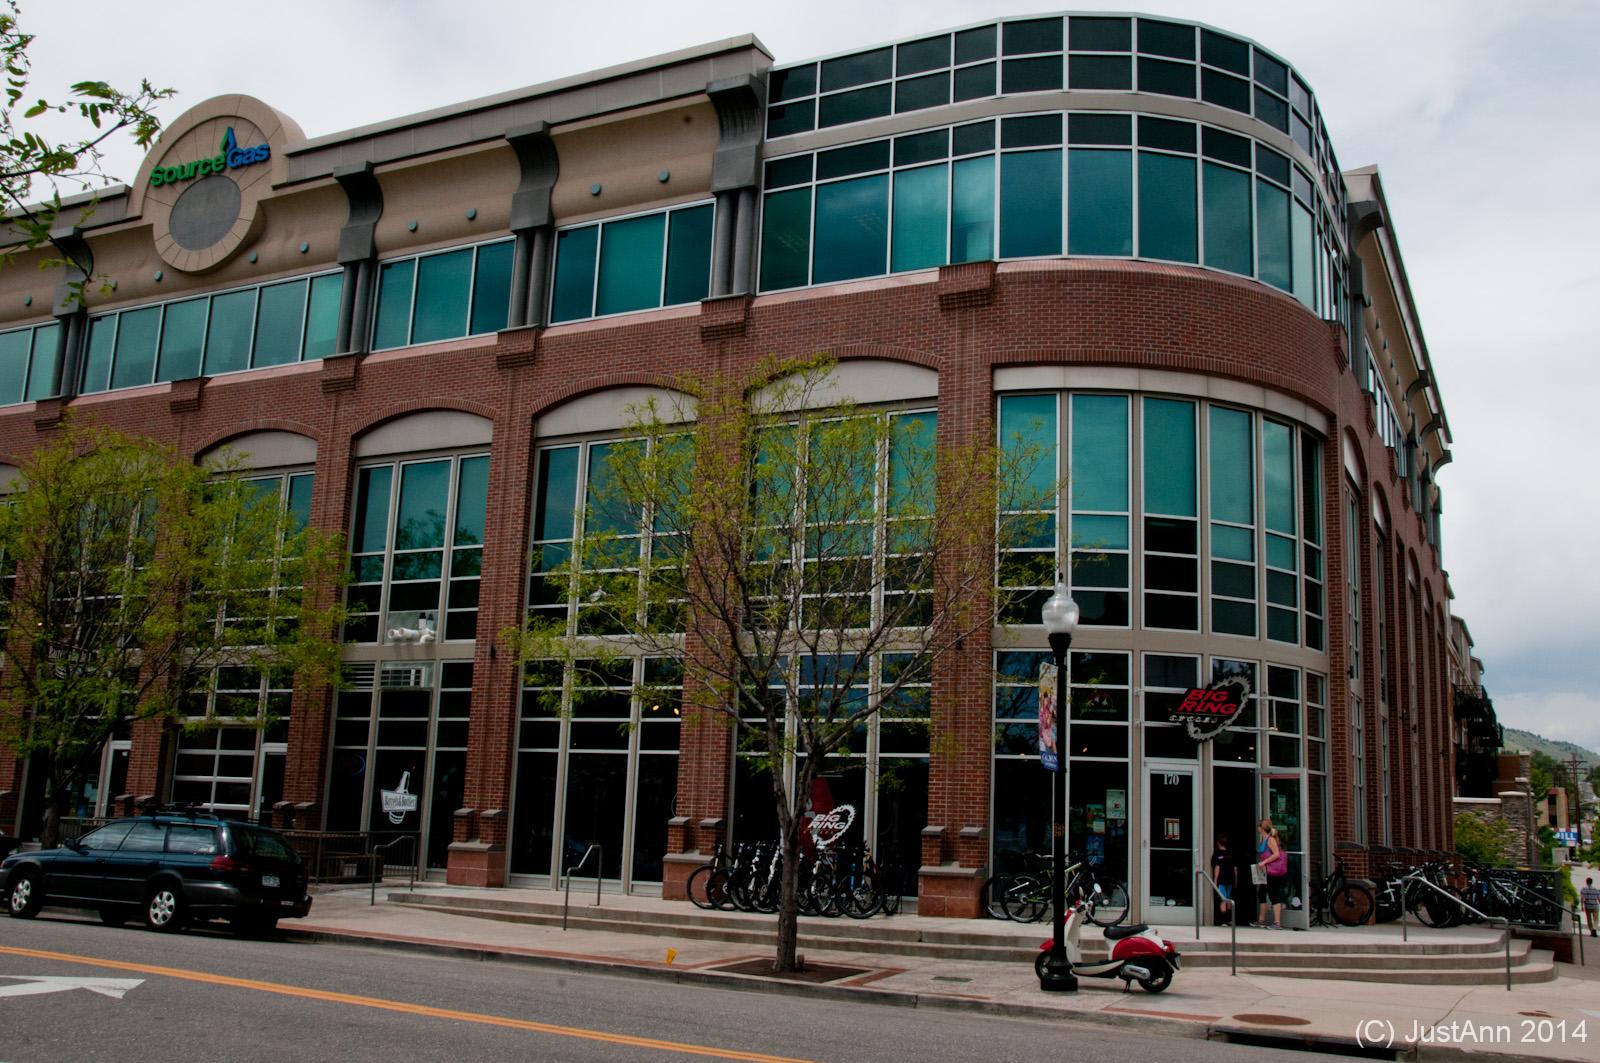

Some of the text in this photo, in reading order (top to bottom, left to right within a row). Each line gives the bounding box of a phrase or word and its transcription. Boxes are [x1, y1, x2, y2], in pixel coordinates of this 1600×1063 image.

[1185, 688, 1231, 703] BIG
[1175, 700, 1238, 715] RING
[1163, 774, 1180, 786] 170
[813, 813, 841, 822] BIG
[807, 821, 846, 829] RING
